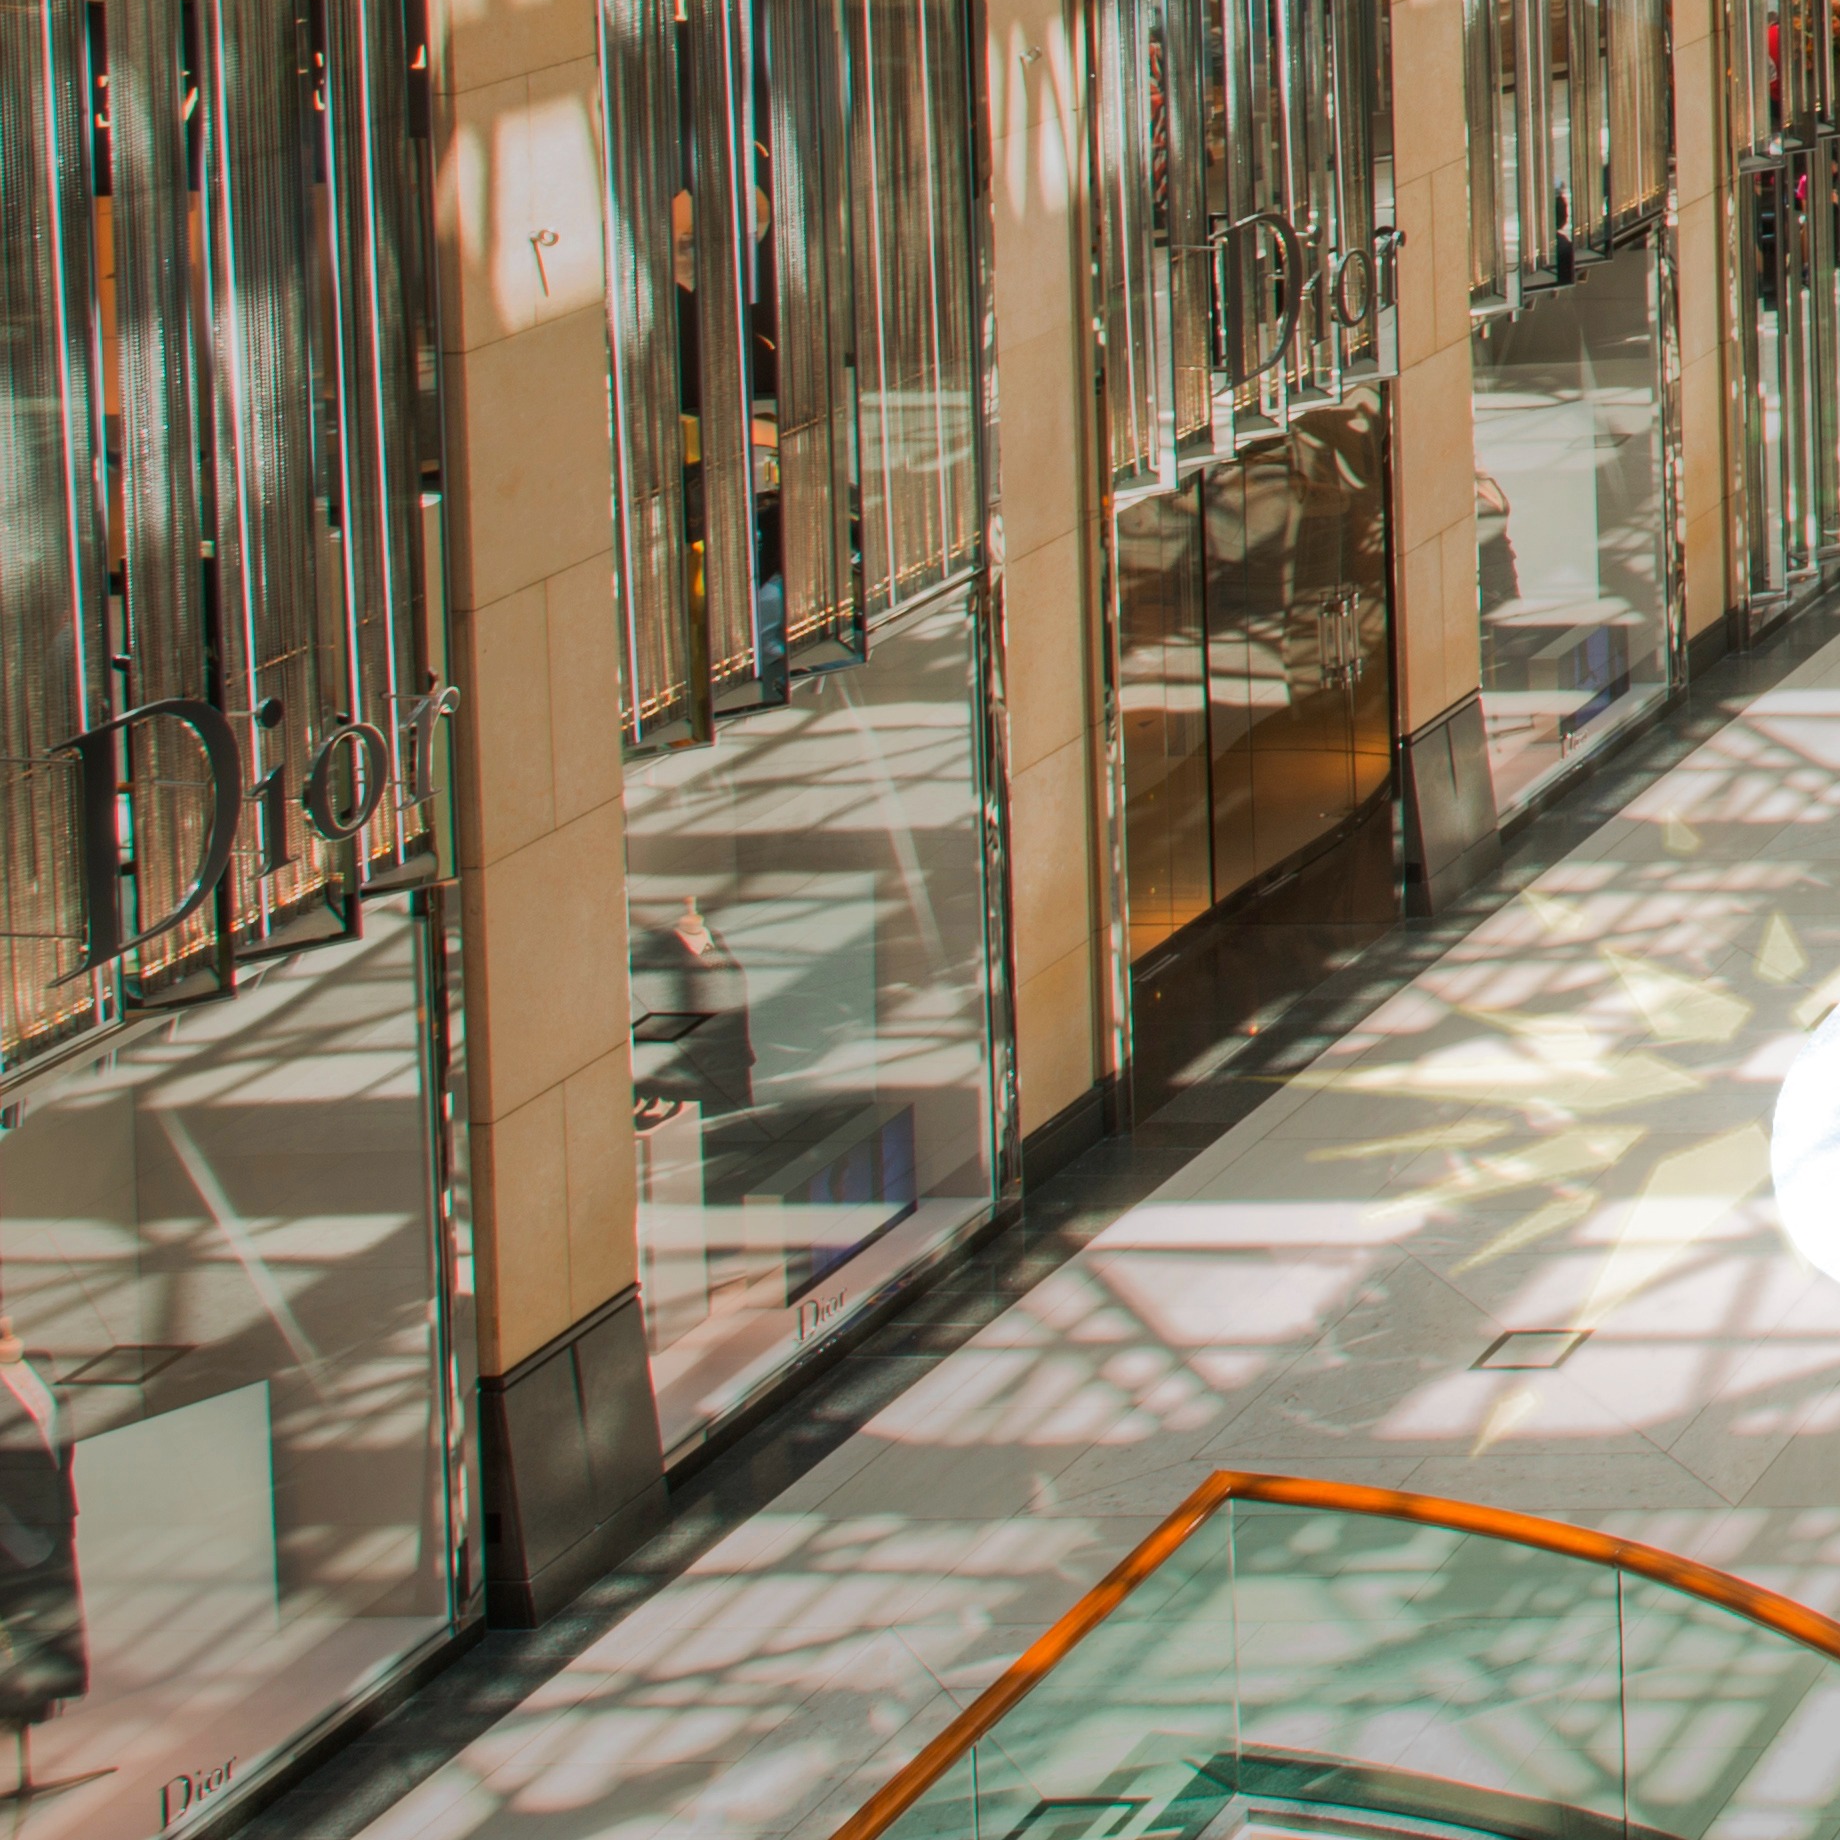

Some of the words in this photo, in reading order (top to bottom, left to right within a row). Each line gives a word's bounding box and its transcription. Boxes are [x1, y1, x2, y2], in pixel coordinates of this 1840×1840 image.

[1208, 212, 1407, 397] Dior
[45, 686, 460, 988] Dior
[798, 1286, 848, 1342] Dior
[158, 1757, 238, 1832] Dior
